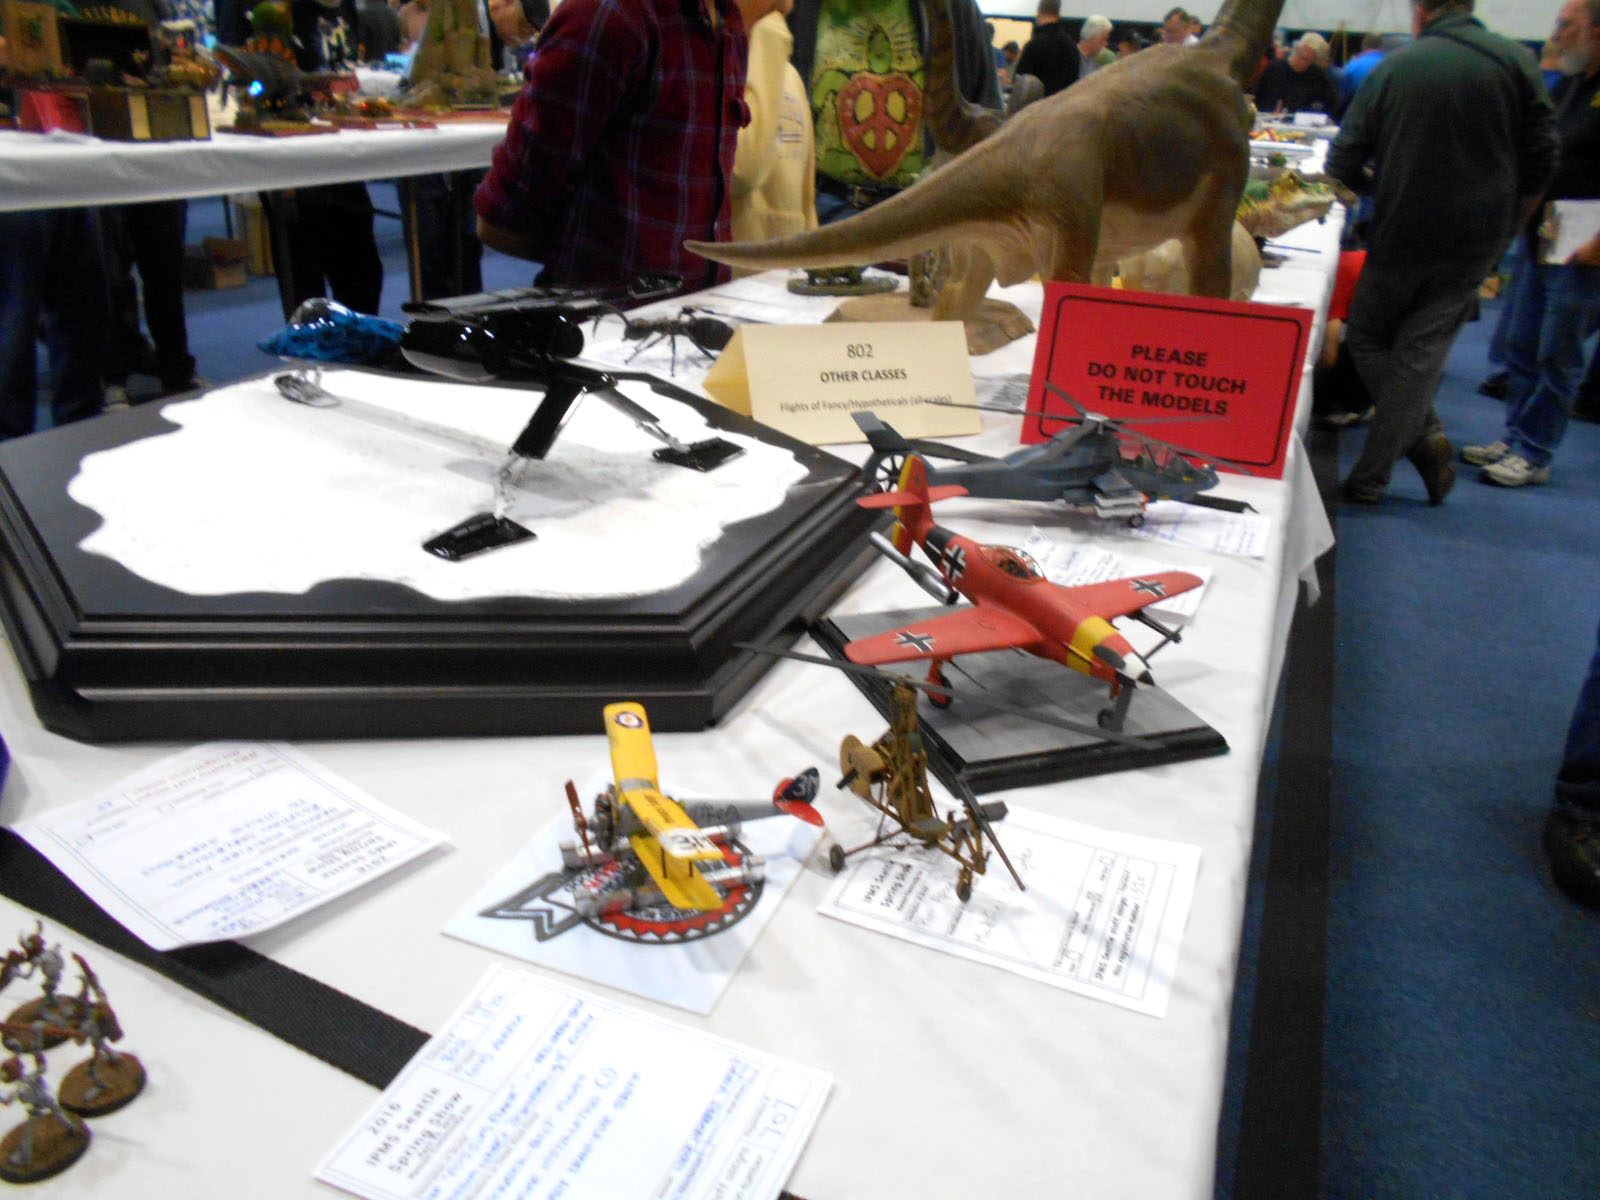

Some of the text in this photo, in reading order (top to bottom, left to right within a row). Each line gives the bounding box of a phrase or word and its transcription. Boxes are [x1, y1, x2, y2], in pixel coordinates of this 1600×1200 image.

[846, 343, 874, 359] 802
[1132, 344, 1208, 367] PLEASE
[820, 369, 907, 383] OTHER CLASSES
[1087, 361, 1247, 395] DO NOT TOUCH
[811, 401, 820, 410] of
[1098, 385, 1229, 416] THE MODELS
[363, 1132, 403, 1169] IPMS
[392, 1084, 443, 1133] Seattle
[365, 1100, 404, 1136] 2016
[385, 1125, 438, 1176] Spring
[424, 1089, 466, 1127] Show
